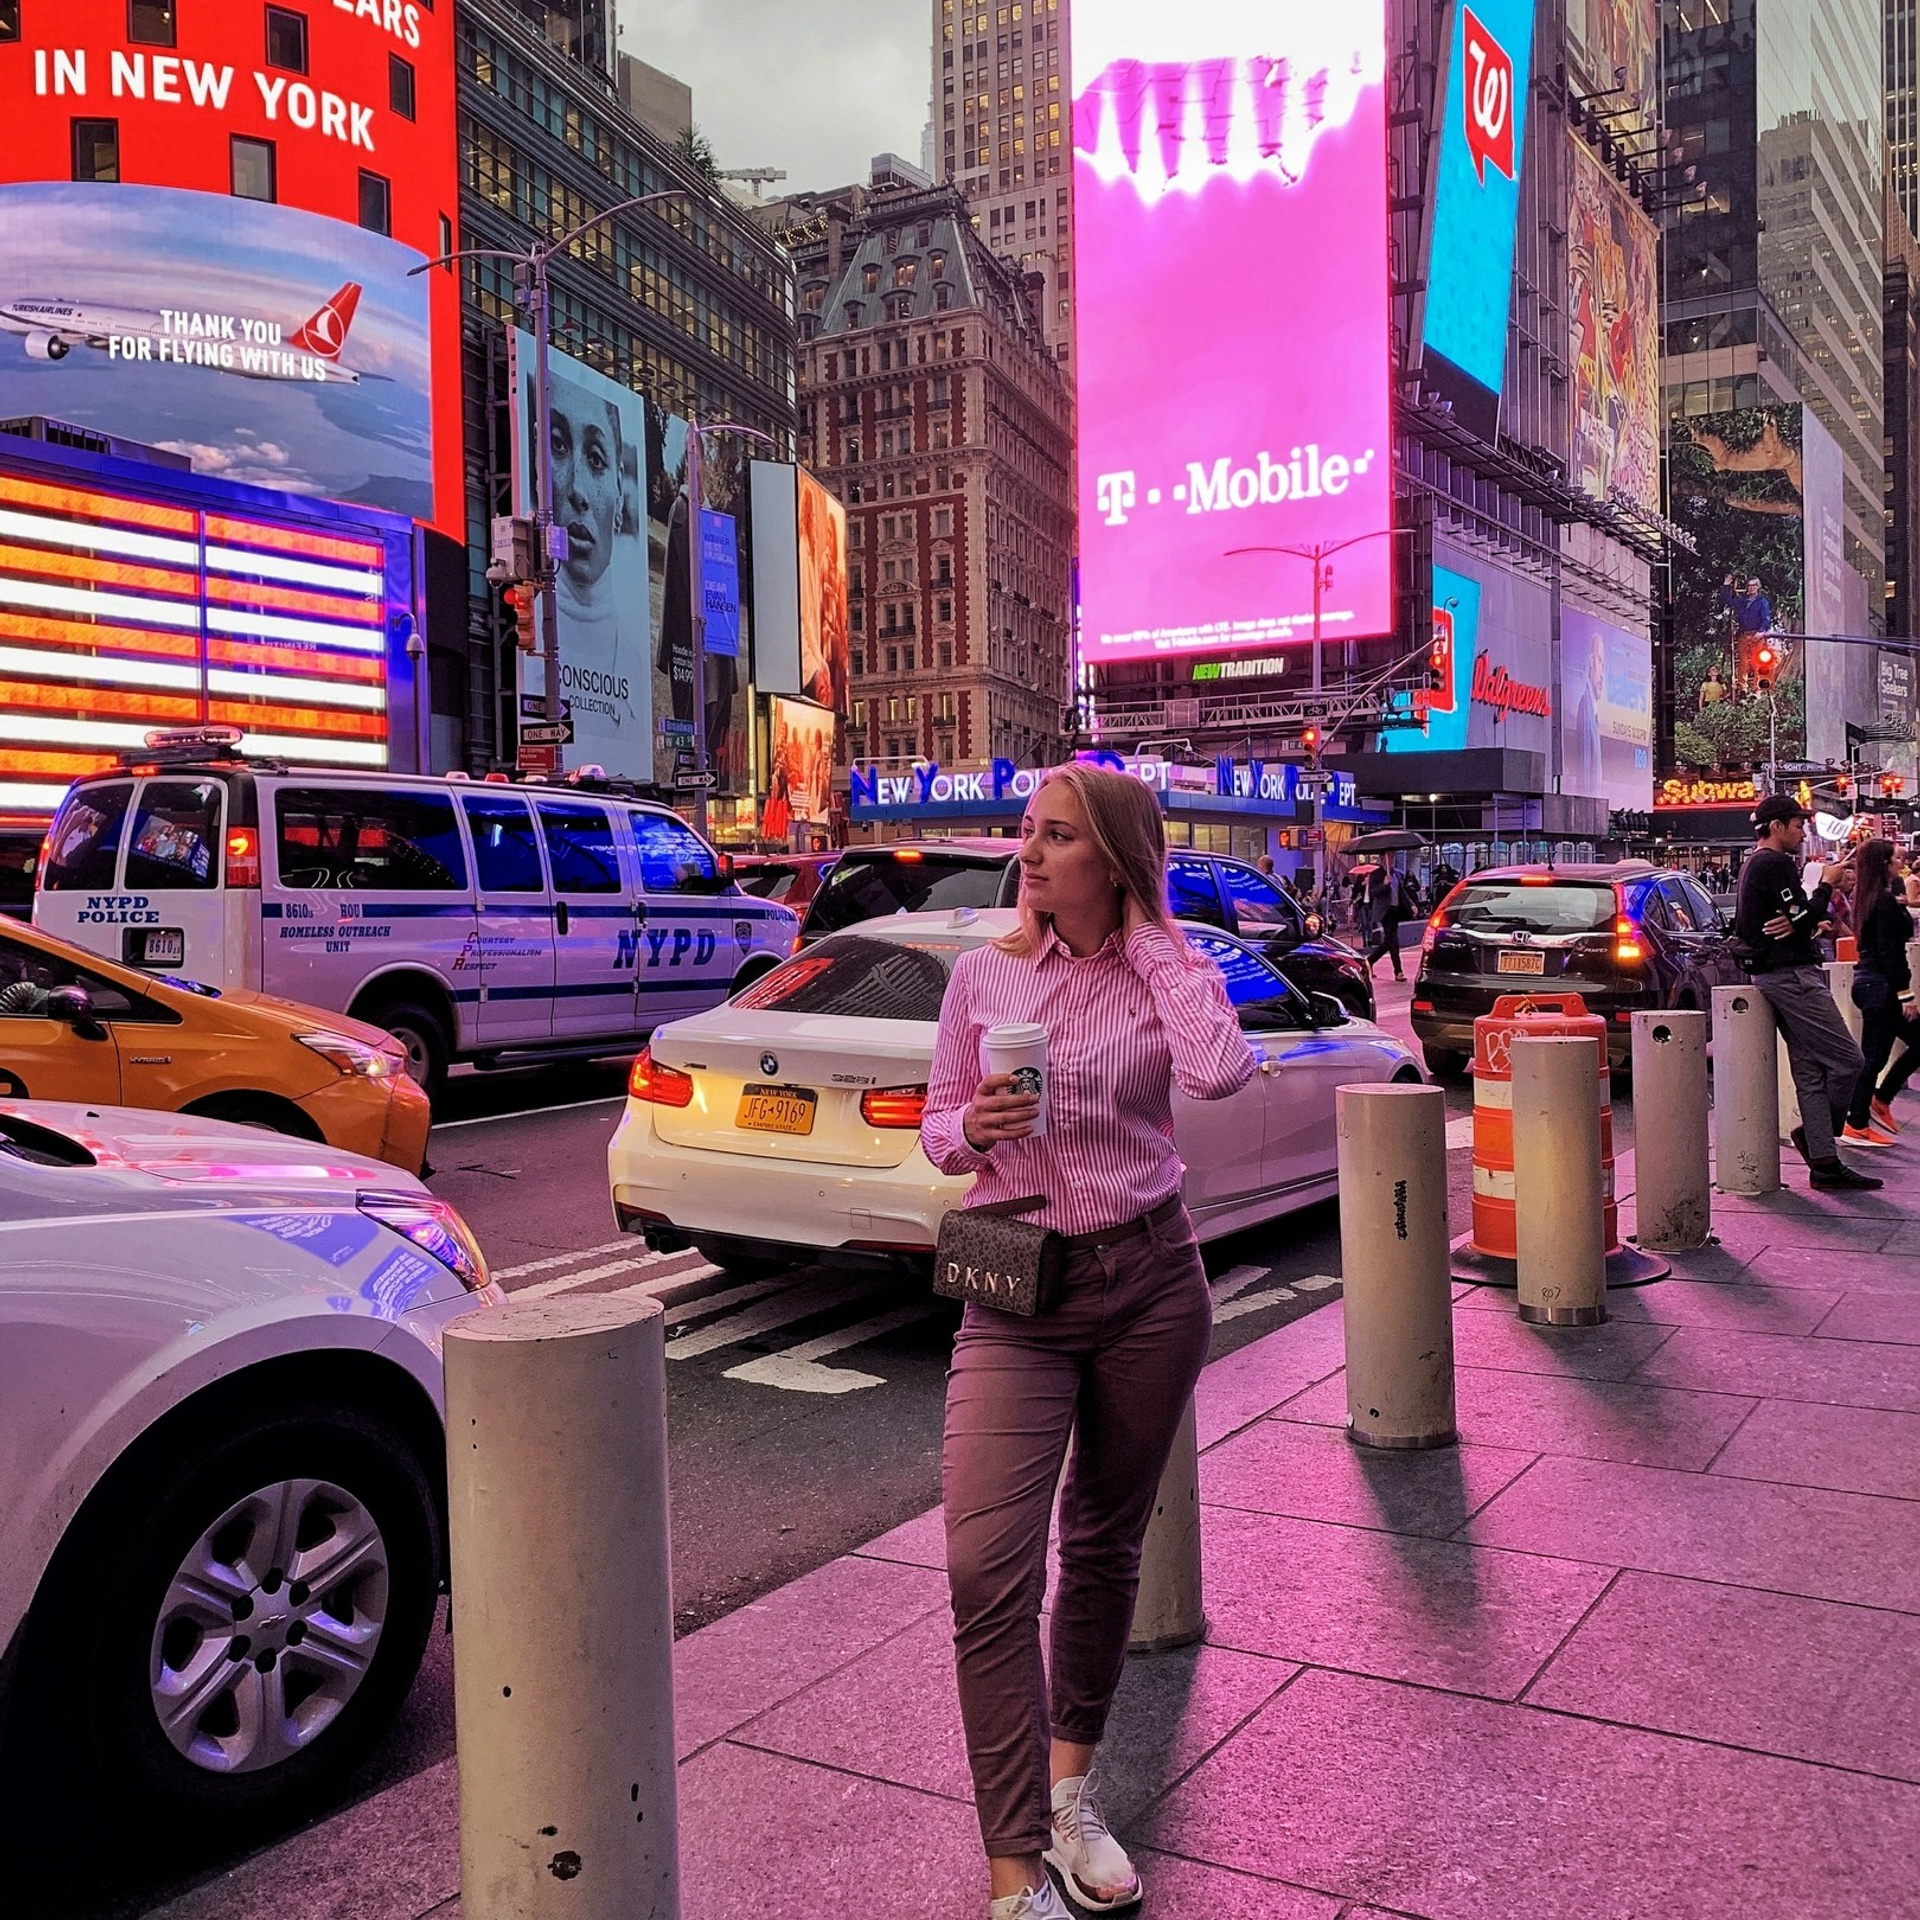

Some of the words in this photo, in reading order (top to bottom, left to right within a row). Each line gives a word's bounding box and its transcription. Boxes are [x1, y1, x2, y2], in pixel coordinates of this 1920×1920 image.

[34, 49, 86, 96] IN
[110, 50, 235, 110] NEW
[253, 71, 376, 152] YORK
[12, 304, 39, 313] TURKISH
[39, 306, 74, 317] AIRLINES
[159, 309, 236, 340] THANK
[242, 318, 282, 346] YOU
[108, 336, 152, 361] FOR
[159, 338, 234, 368] FLYING
[241, 347, 295, 377] WITH
[301, 357, 327, 382] US
[706, 598, 736, 613] HANSEN
[1881, 661, 1893, 681] Big
[1893, 663, 1909, 681] Tree
[560, 664, 630, 700] ONSCIOUS
[1472, 652, 1553, 723] Walgreens
[1881, 679, 1908, 698] Seekers
[527, 702, 543, 711] ONE
[569, 695, 616, 716] COLLECTION
[527, 730, 544, 739] ONE
[550, 727, 567, 738] WAY
[850, 764, 910, 807] NEW
[914, 761, 985, 804] YORK
[1217, 755, 1250, 797] NEW
[1251, 760, 1285, 801] YORK
[87, 896, 150, 909] NYPD
[77, 911, 160, 923] POLICE
[341, 903, 360, 919] HOU
[280, 926, 335, 938] HOMELESS
[338, 926, 391, 938] OUTREACH
[466, 931, 516, 944] COURTESY
[149, 939, 173, 954] 8610
[326, 941, 351, 952] UNIT
[460, 944, 542, 957] PROFESSIONALISM
[613, 928, 716, 969] NYPD
[451, 957, 498, 970] RESPECT
[760, 1087, 778, 1097] NEW
[779, 1089, 798, 1099] YORK
[753, 1121, 774, 1129] EMPIRE
[776, 1123, 793, 1131] STATE
[948, 1262, 1022, 1297] DKNY
